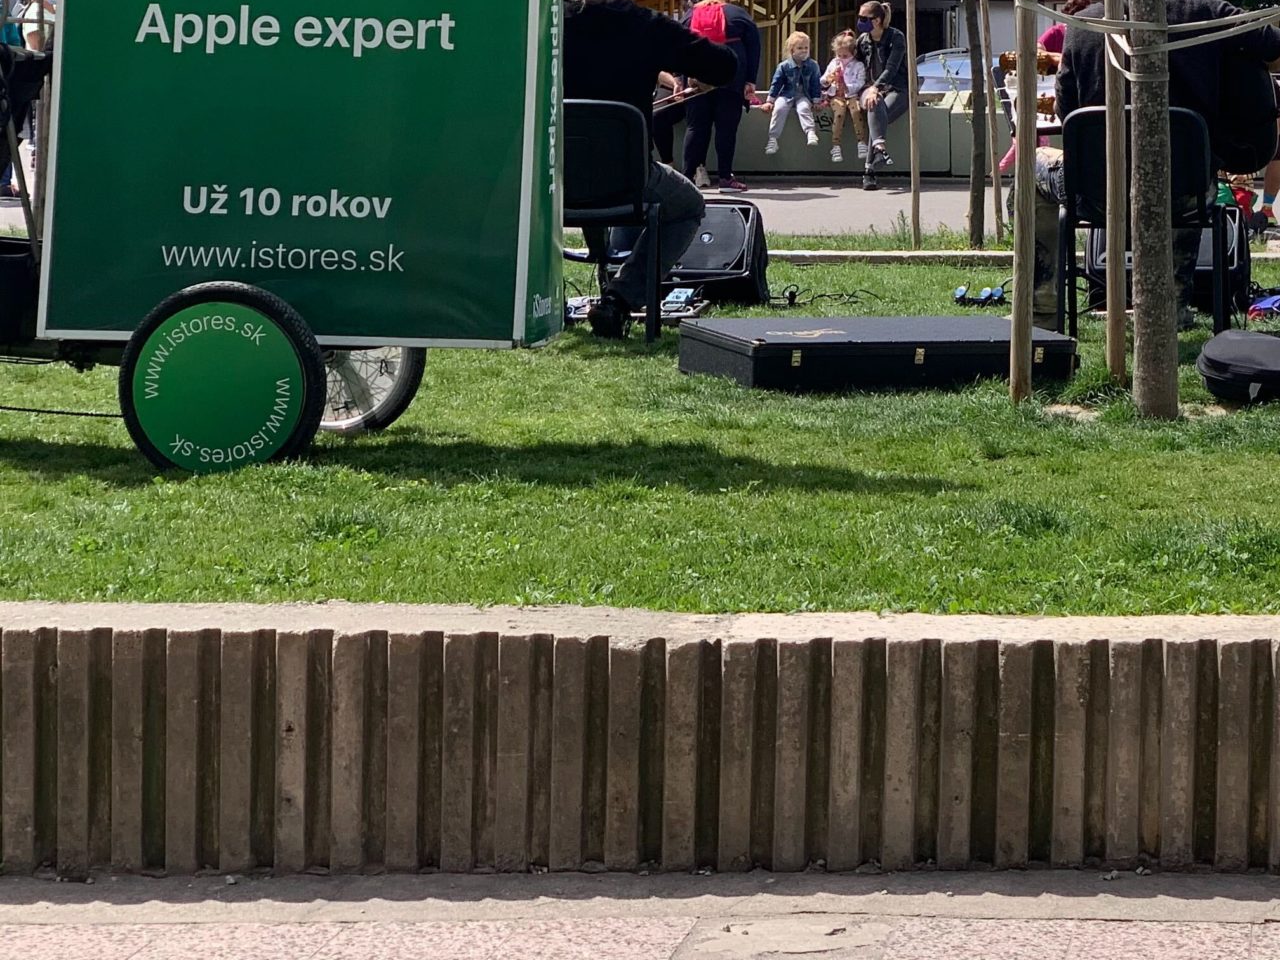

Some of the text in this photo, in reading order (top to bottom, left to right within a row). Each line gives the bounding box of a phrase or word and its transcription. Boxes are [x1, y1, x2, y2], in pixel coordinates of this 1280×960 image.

[134, 3, 456, 58] Apple expert
[183, 184, 392, 219] Už 10 rokov
[161, 240, 405, 272] www.istores.sk
[144, 315, 267, 399] www.istores.sk
[169, 377, 291, 463] www.istores.sk
